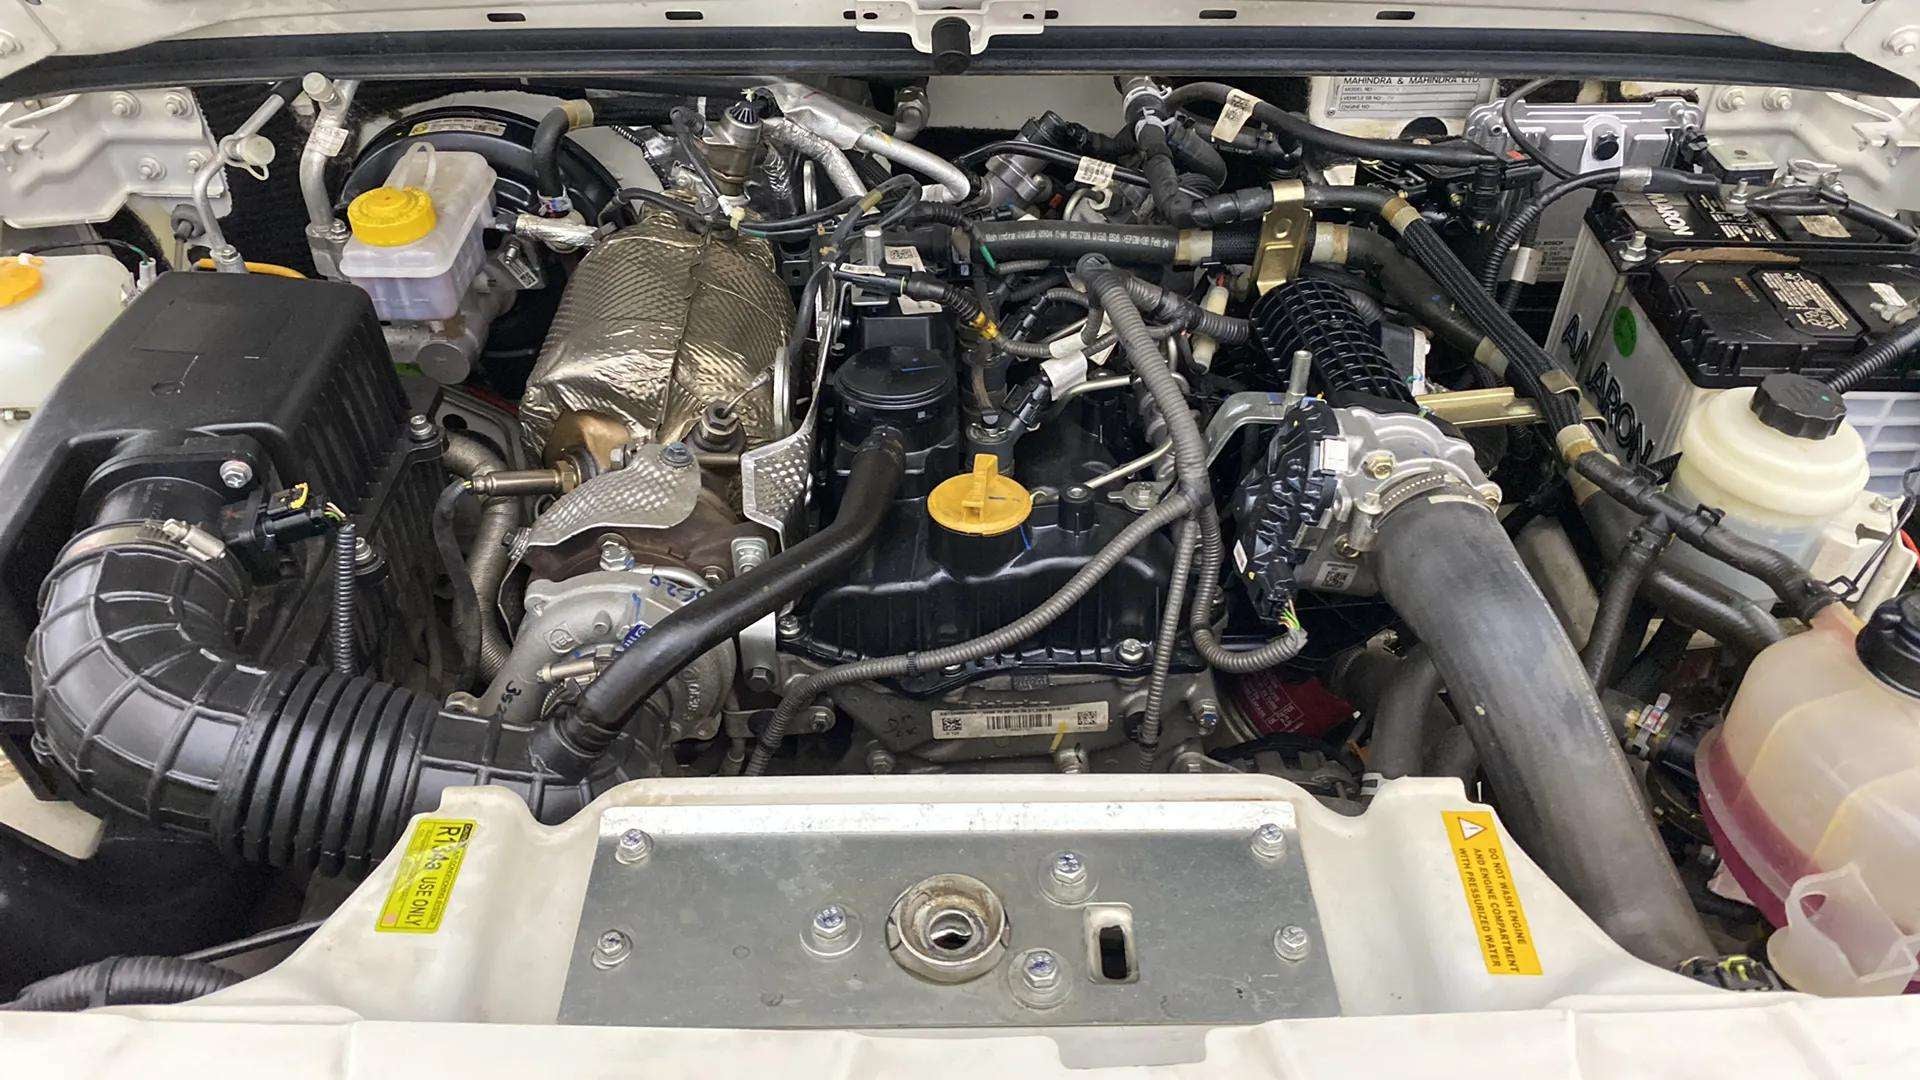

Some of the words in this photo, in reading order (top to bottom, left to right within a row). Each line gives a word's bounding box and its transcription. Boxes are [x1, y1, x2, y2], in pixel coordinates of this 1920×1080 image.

[1343, 76, 1392, 85] MAHINDRA
[1408, 76, 1458, 84] MAHINDRA
[1645, 193, 1695, 236] MARON
[425, 826, 462, 870] R14a
[1489, 848, 1499, 860] DO
[1493, 861, 1506, 880] NOT
[415, 877, 437, 897] USE
[1500, 881, 1513, 906] WASH
[404, 898, 429, 926] ONLY
[1459, 848, 1470, 869] WITH
[1466, 871, 1491, 933] PRESSURIZED
[1484, 934, 1501, 967] WATER
[1474, 848, 1485, 866] AND
[1480, 867, 1497, 900] ENGINE
[1490, 902, 1520, 973] COMPARTMENT
[1508, 907, 1527, 945] ENGINE
